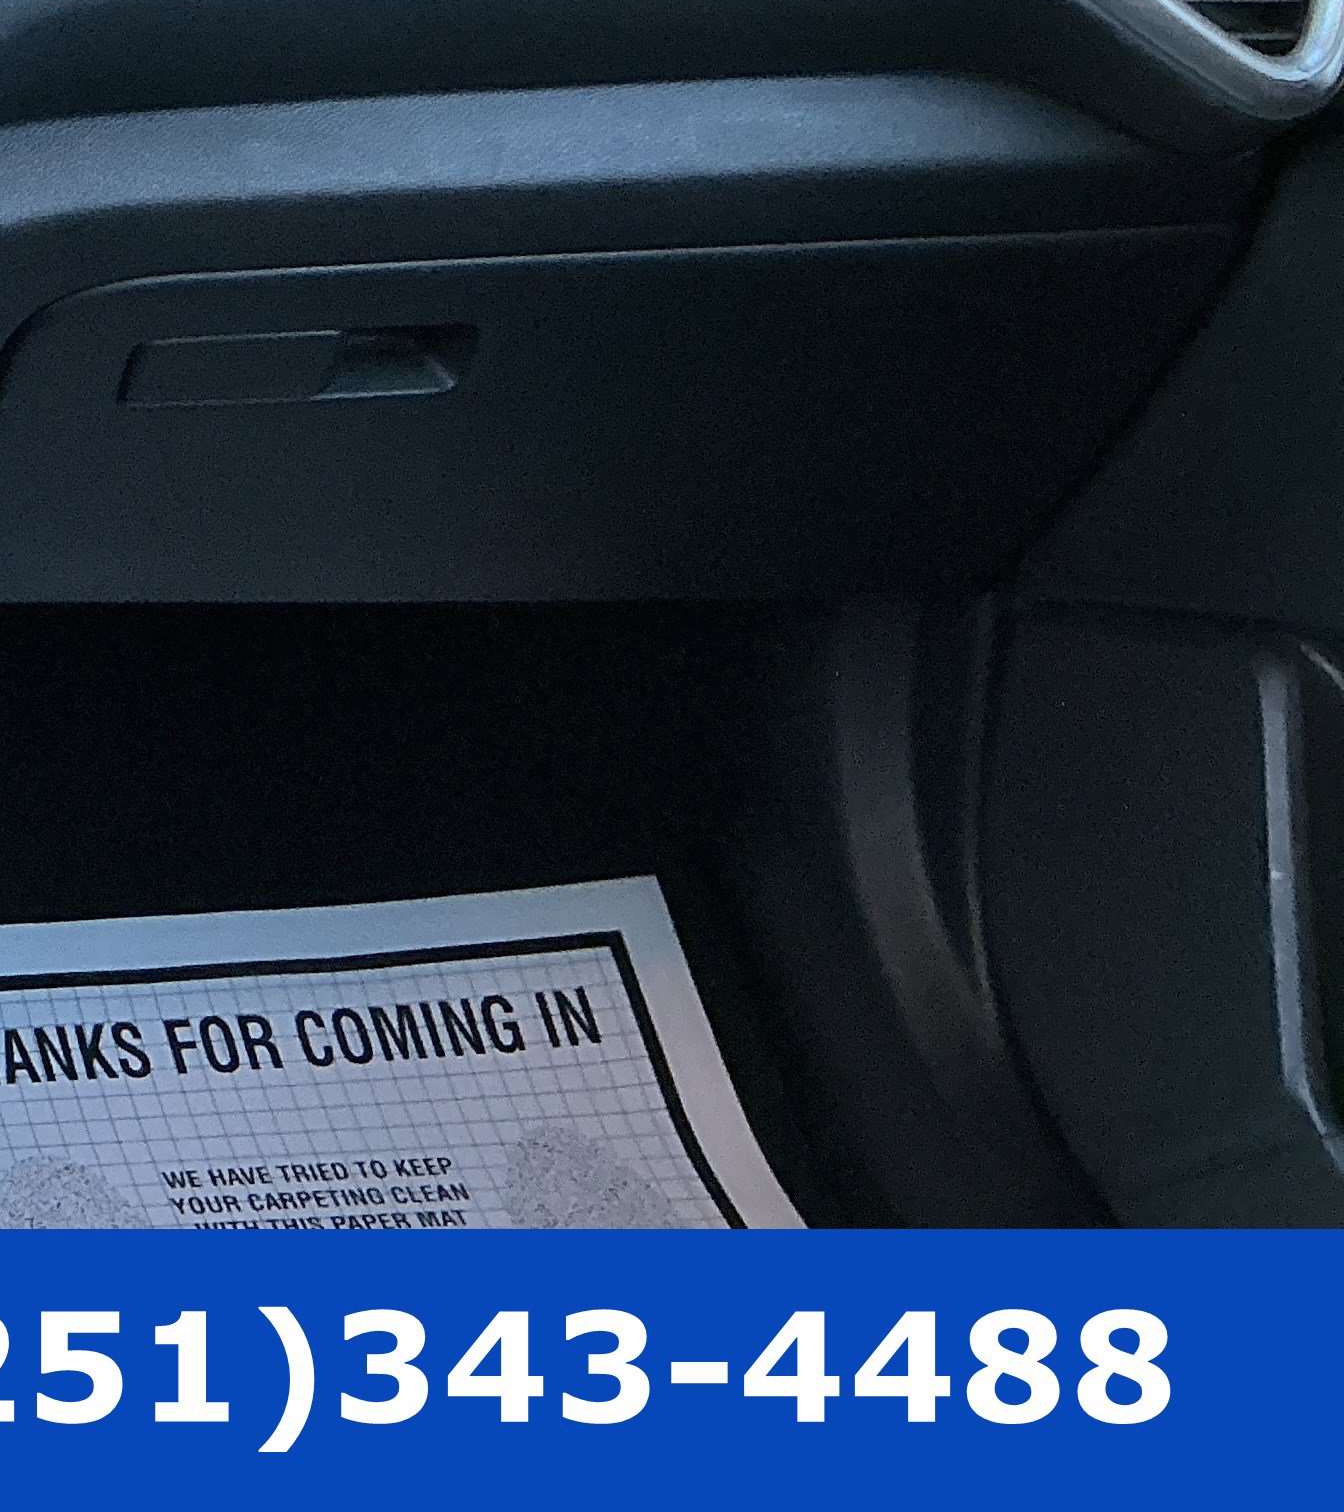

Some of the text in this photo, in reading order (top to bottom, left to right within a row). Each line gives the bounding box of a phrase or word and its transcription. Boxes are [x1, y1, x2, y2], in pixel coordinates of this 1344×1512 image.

[164, 1014, 283, 1075] FOR
[294, 994, 527, 1067] COMING
[535, 987, 603, 1049] IN
[162, 1157, 453, 1190] WE HAVE TRIED TO KEEP
[169, 1183, 471, 1215] YOUR CARPETING CLEAN
[330, 1211, 412, 1229] PAPER
[417, 1209, 469, 1228] MAT
